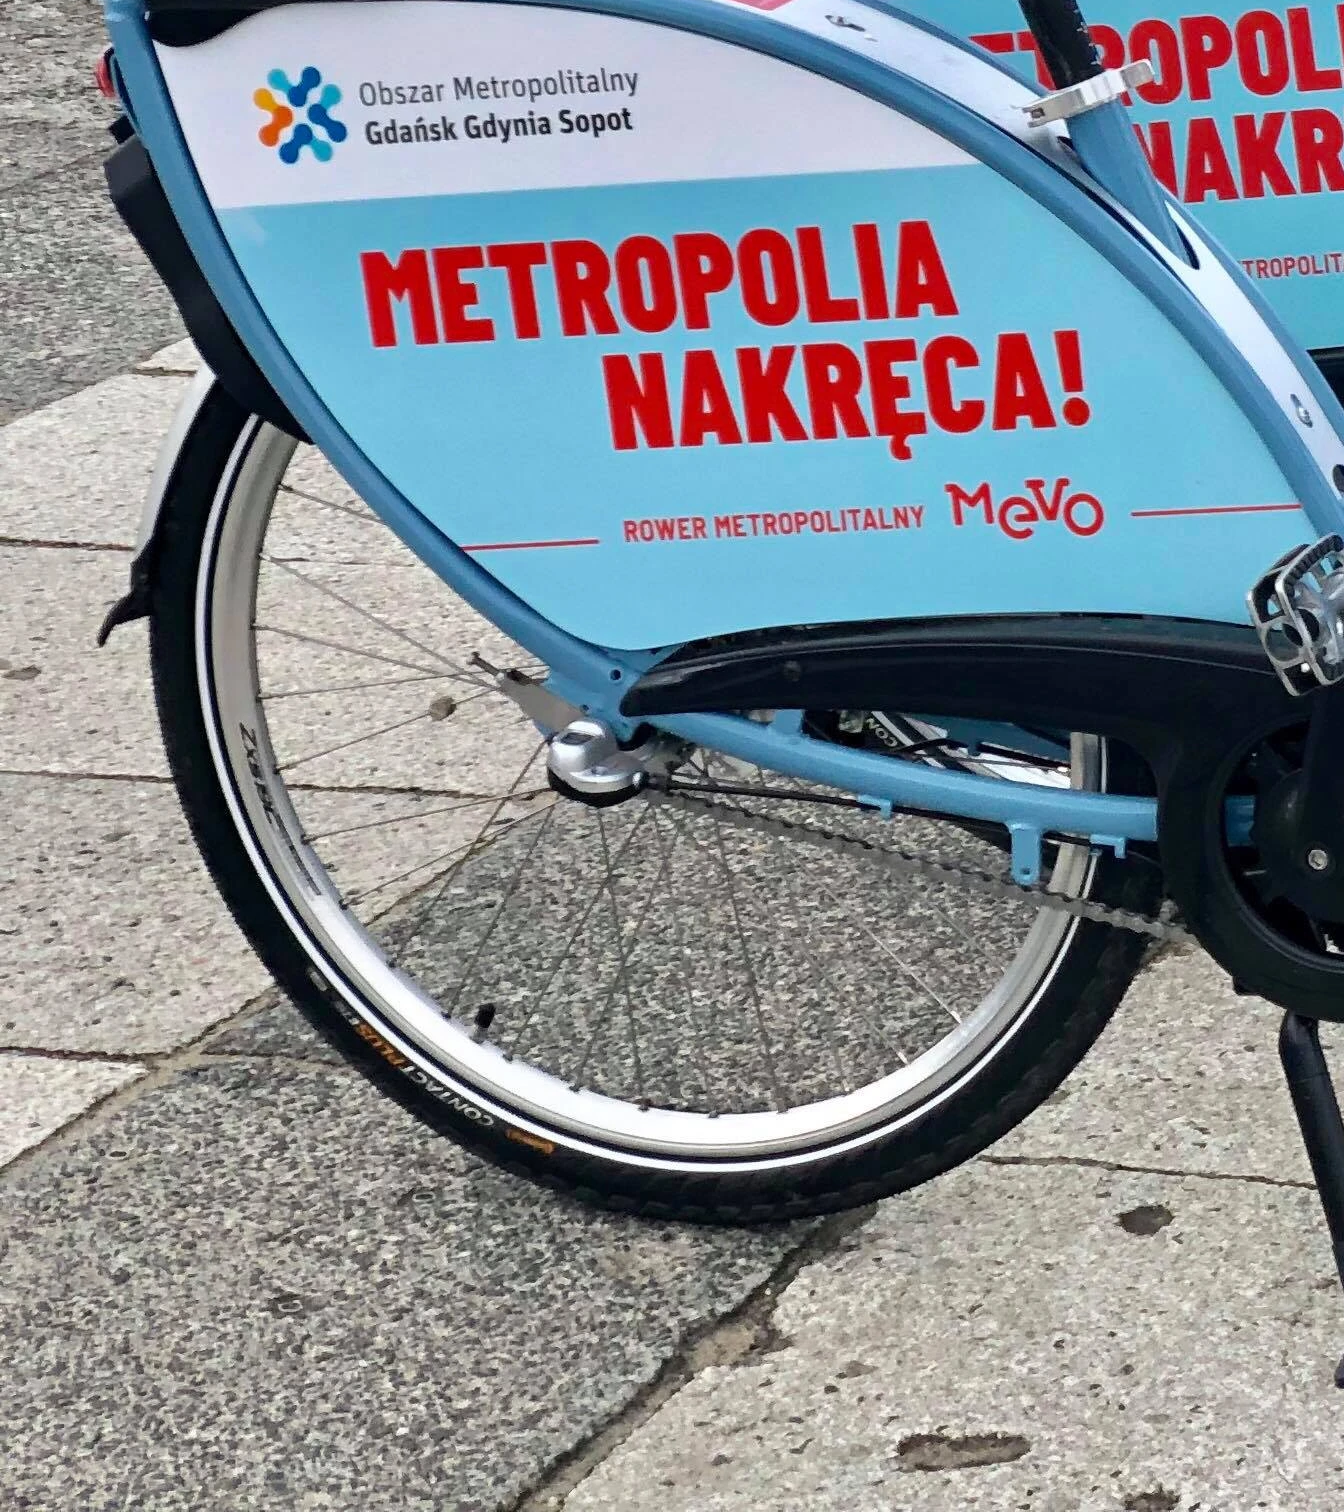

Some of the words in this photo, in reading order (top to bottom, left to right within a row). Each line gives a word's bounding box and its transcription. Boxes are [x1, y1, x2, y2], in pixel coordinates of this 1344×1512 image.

[359, 80, 445, 108] Obszar
[454, 66, 640, 103] Metropolitalny
[364, 115, 458, 146] Gdańsk
[463, 113, 553, 144] Gdynia
[558, 106, 634, 135] Sopot
[360, 219, 960, 349] METROPOLIA
[600, 329, 1092, 461] NAKRĘCA!
[623, 515, 708, 543] ROWER
[714, 504, 926, 539] METROPOLITALNY
